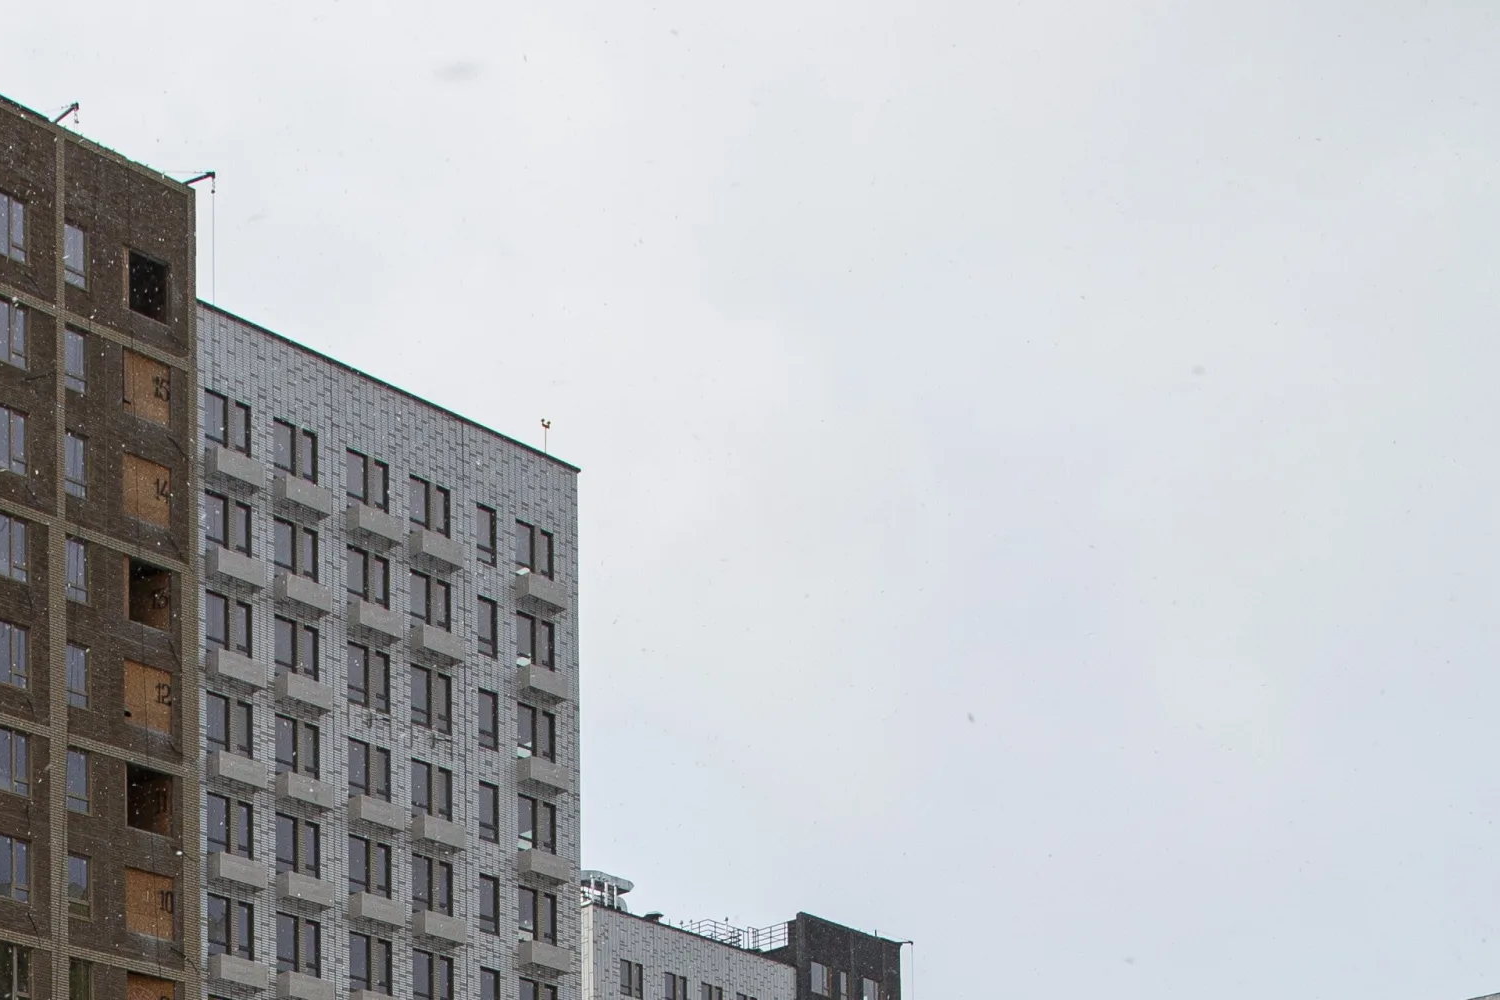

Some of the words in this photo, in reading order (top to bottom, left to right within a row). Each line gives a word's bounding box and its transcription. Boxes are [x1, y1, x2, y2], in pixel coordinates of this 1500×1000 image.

[152, 376, 170, 402] 15
[154, 477, 170, 504] 14
[155, 682, 172, 707] 12
[160, 890, 174, 915] 10
